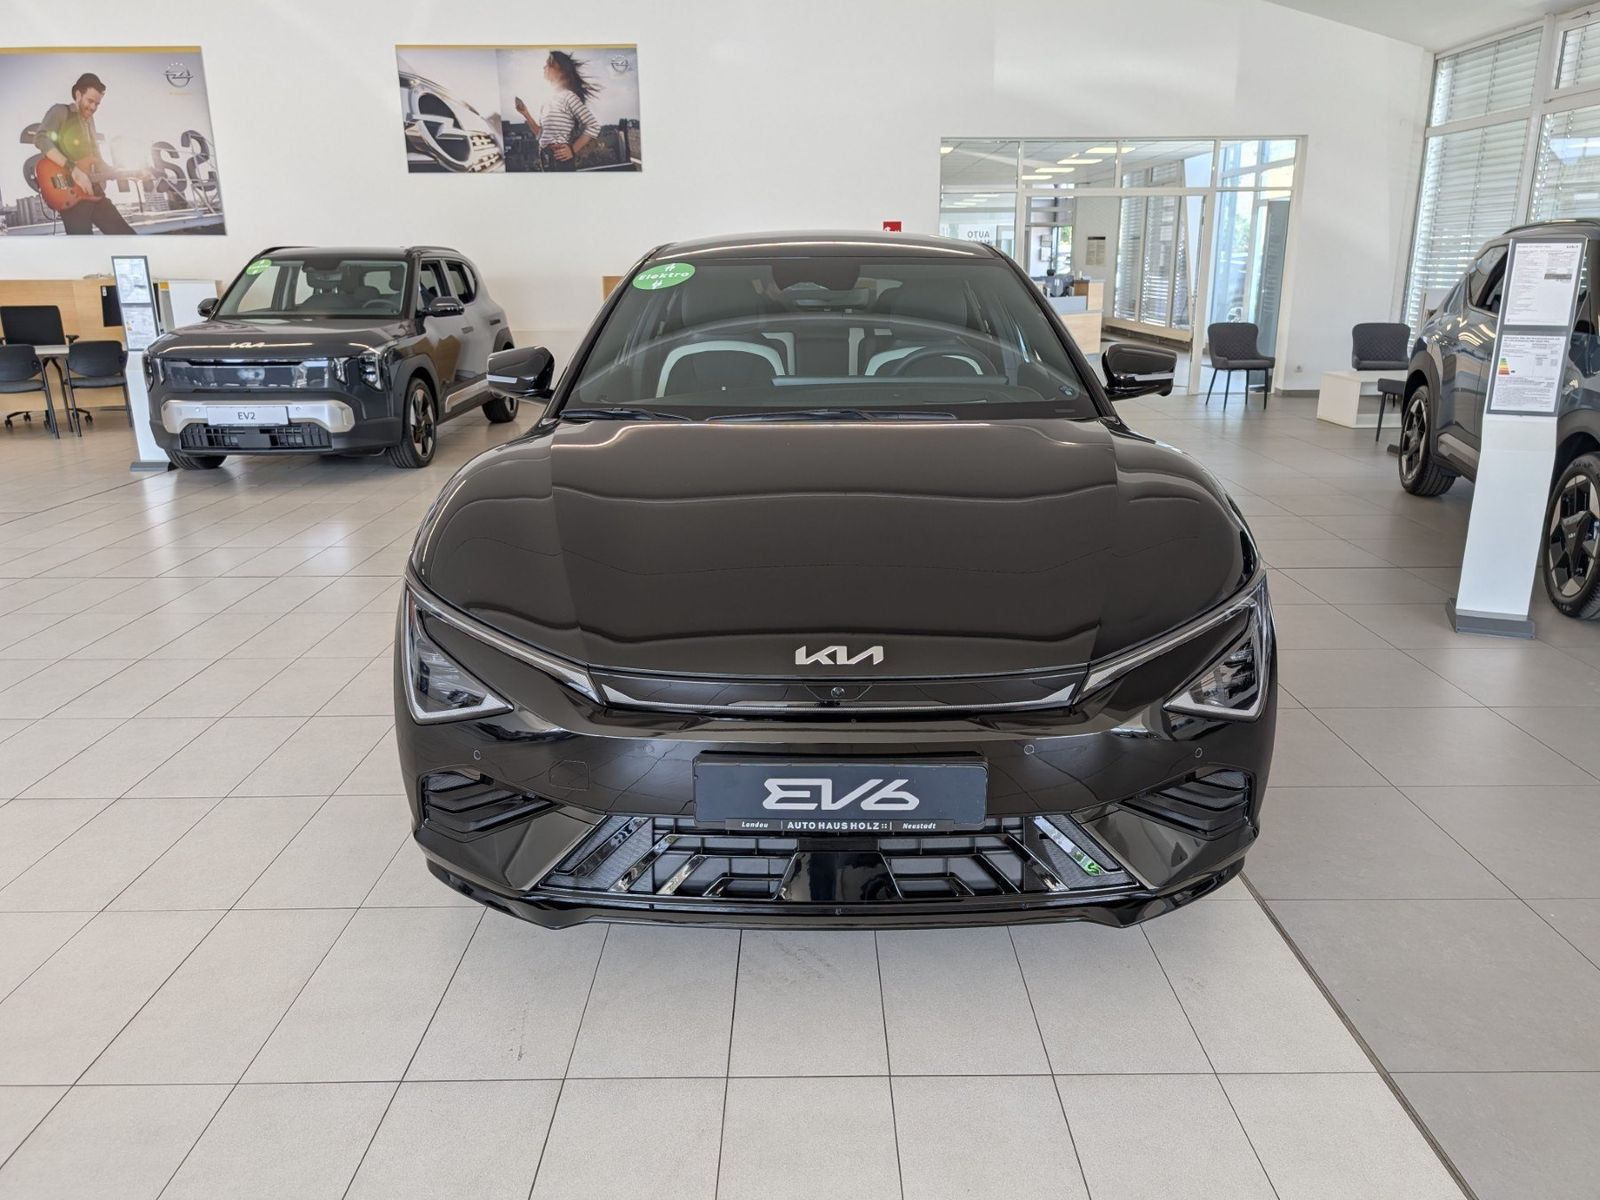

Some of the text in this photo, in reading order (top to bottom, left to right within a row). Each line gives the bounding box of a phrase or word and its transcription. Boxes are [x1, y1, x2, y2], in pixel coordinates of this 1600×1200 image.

[237, 411, 256, 420] EV2
[795, 645, 884, 665] KIA
[762, 778, 920, 811] EV6
[787, 822, 816, 830] AUTO
[818, 822, 848, 830] HAUS
[850, 822, 880, 830] HOLZ
[902, 822, 937, 830] Neustadt
